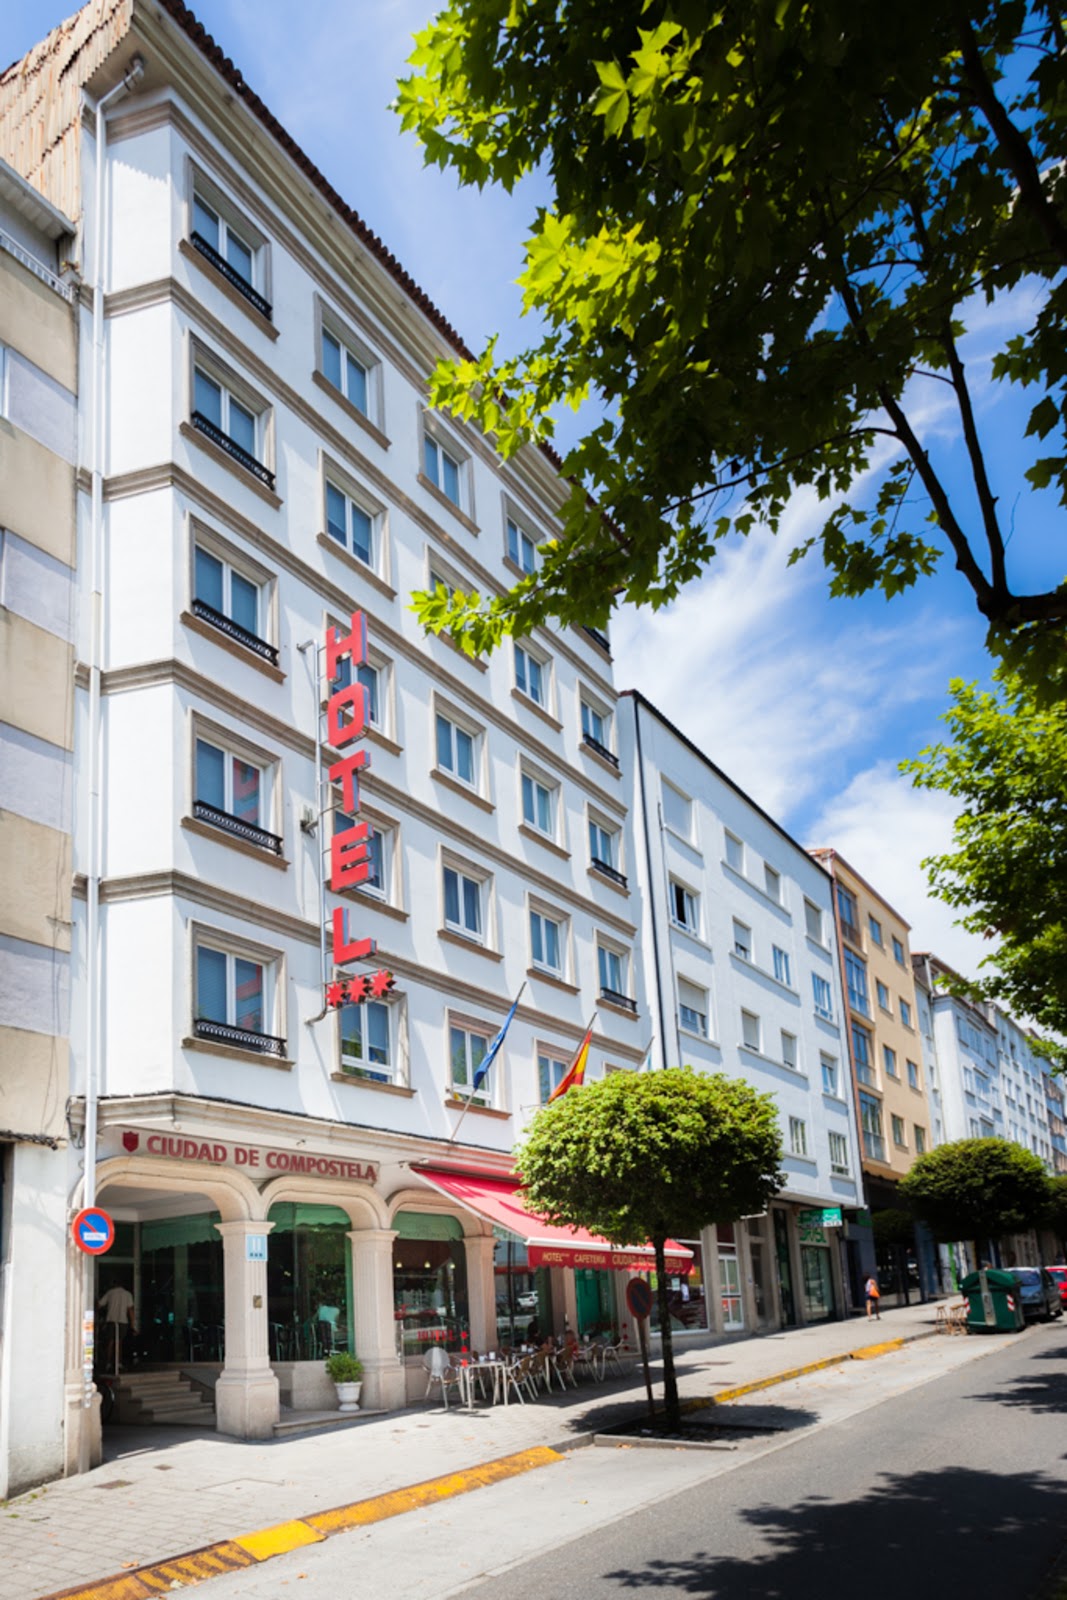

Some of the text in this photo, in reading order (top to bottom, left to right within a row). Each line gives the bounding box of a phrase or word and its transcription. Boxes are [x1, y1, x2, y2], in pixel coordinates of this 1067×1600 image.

[325, 609, 378, 966] HOTEL
[146, 1135, 378, 1182] CIUDAD DE COMPOSTELA
[542, 1252, 563, 1262] HOTEL
